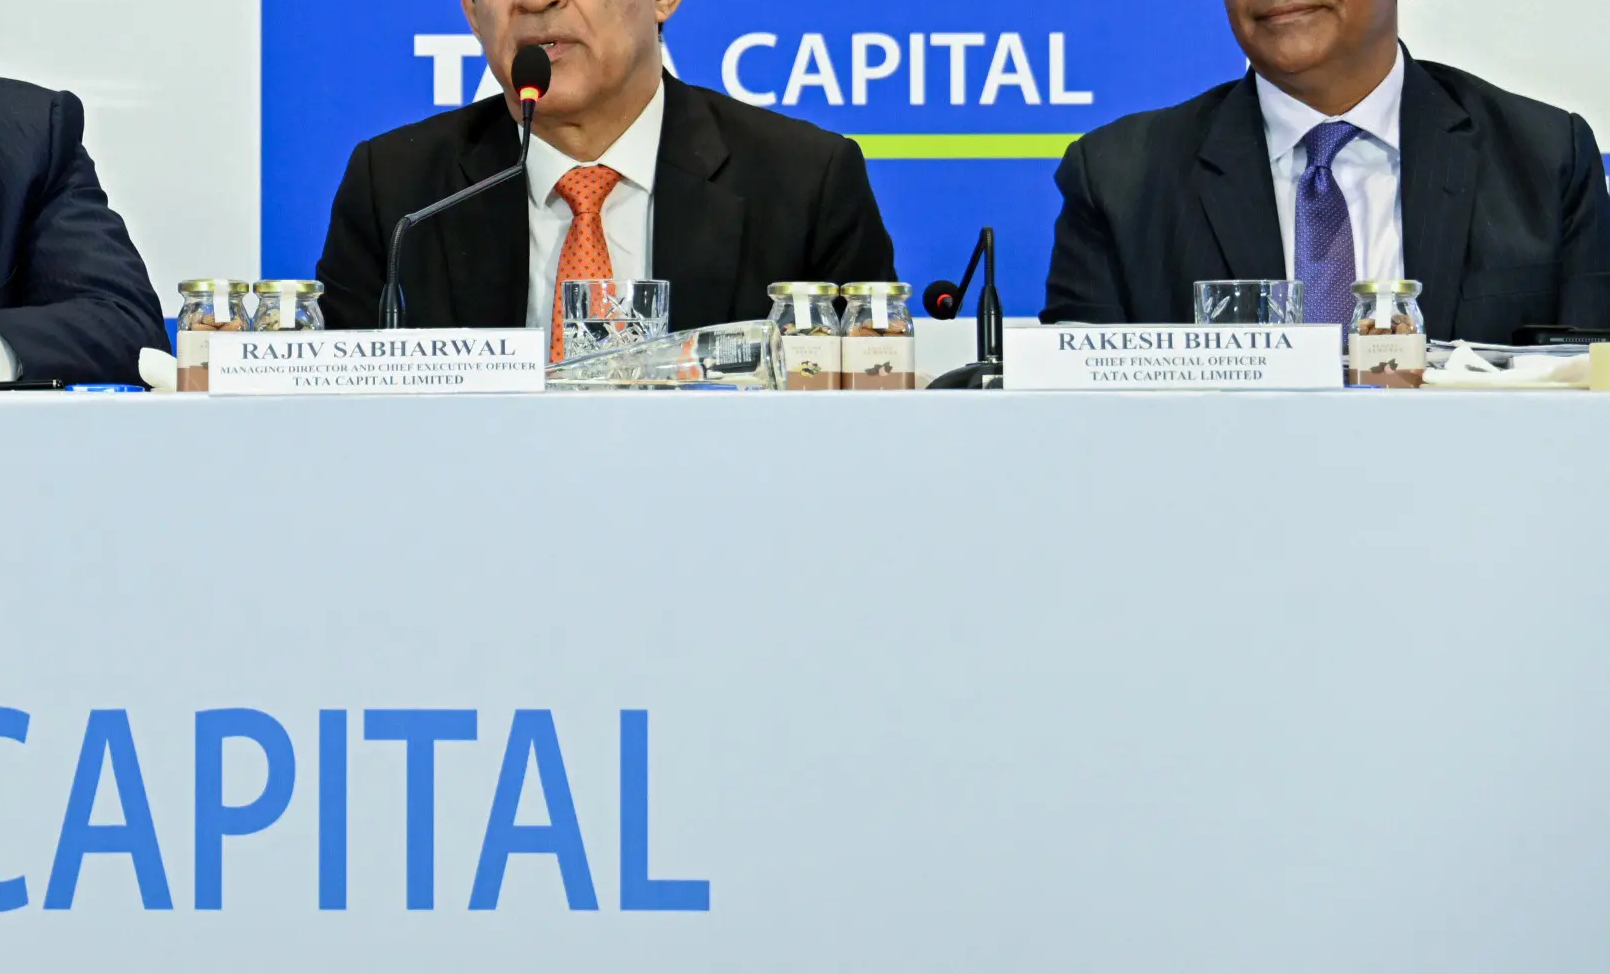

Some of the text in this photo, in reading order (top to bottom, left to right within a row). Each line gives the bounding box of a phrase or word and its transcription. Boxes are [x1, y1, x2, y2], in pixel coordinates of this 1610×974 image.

[722, 33, 1093, 106] CAPITAL
[1058, 332, 1293, 350] RAKESH BHATIA
[241, 339, 516, 359] RAJIV SABHARWAL
[1085, 356, 1267, 366] CHIEF FINANCIAL OFFICER
[220, 362, 536, 374] MANAGING DIRECTOR AND CHIEF EXECUTIVE OFFICER
[292, 374, 464, 386] TATA CAPITAL LIMITED
[1090, 370, 1263, 381] TATA CAPITAL LIMITED
